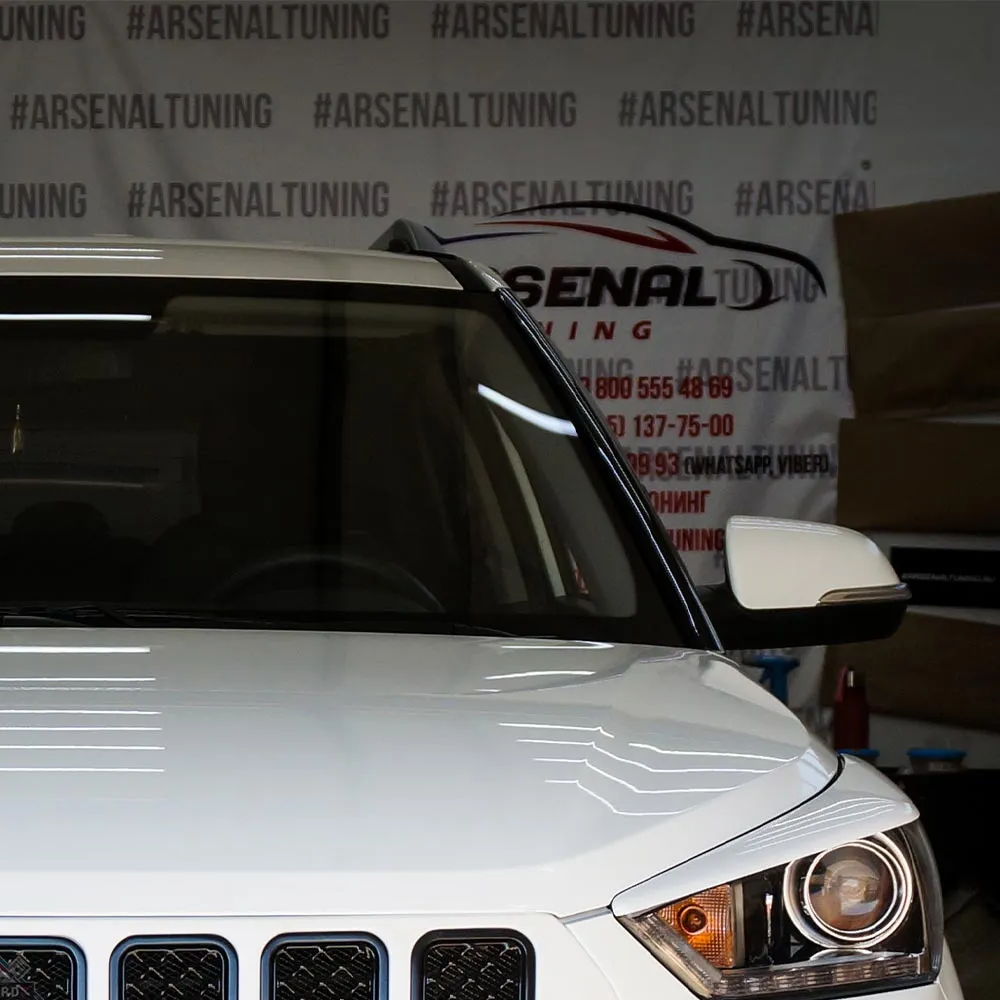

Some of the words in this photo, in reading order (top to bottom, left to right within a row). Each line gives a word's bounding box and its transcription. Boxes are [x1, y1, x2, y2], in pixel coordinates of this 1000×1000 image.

[127, 4, 390, 40] #ARSENALTUNING
[431, 1, 695, 39] #ARSENALTUNING
[736, 0, 880, 38] #ARSENA
[10, 93, 272, 130] #ARSENALTUNING
[313, 92, 577, 128] #ARSENALTUNING
[618, 90, 878, 127] #ARSENALTUNING
[127, 181, 390, 218] #ARSENALTUNING
[431, 180, 694, 217] #ARSENALTUNING
[735, 179, 876, 217] #ARSENA
[489, 265, 717, 308] SENAL
[595, 376, 632, 400] 800
[637, 376, 673, 399] 555
[678, 376, 703, 399] 48
[708, 375, 734, 399] 69
[633, 413, 735, 438] 137-75-00
[654, 453, 680, 476] 93
[684, 455, 774, 475] (WHATSAPP,
[778, 454, 830, 475] VIBER)
